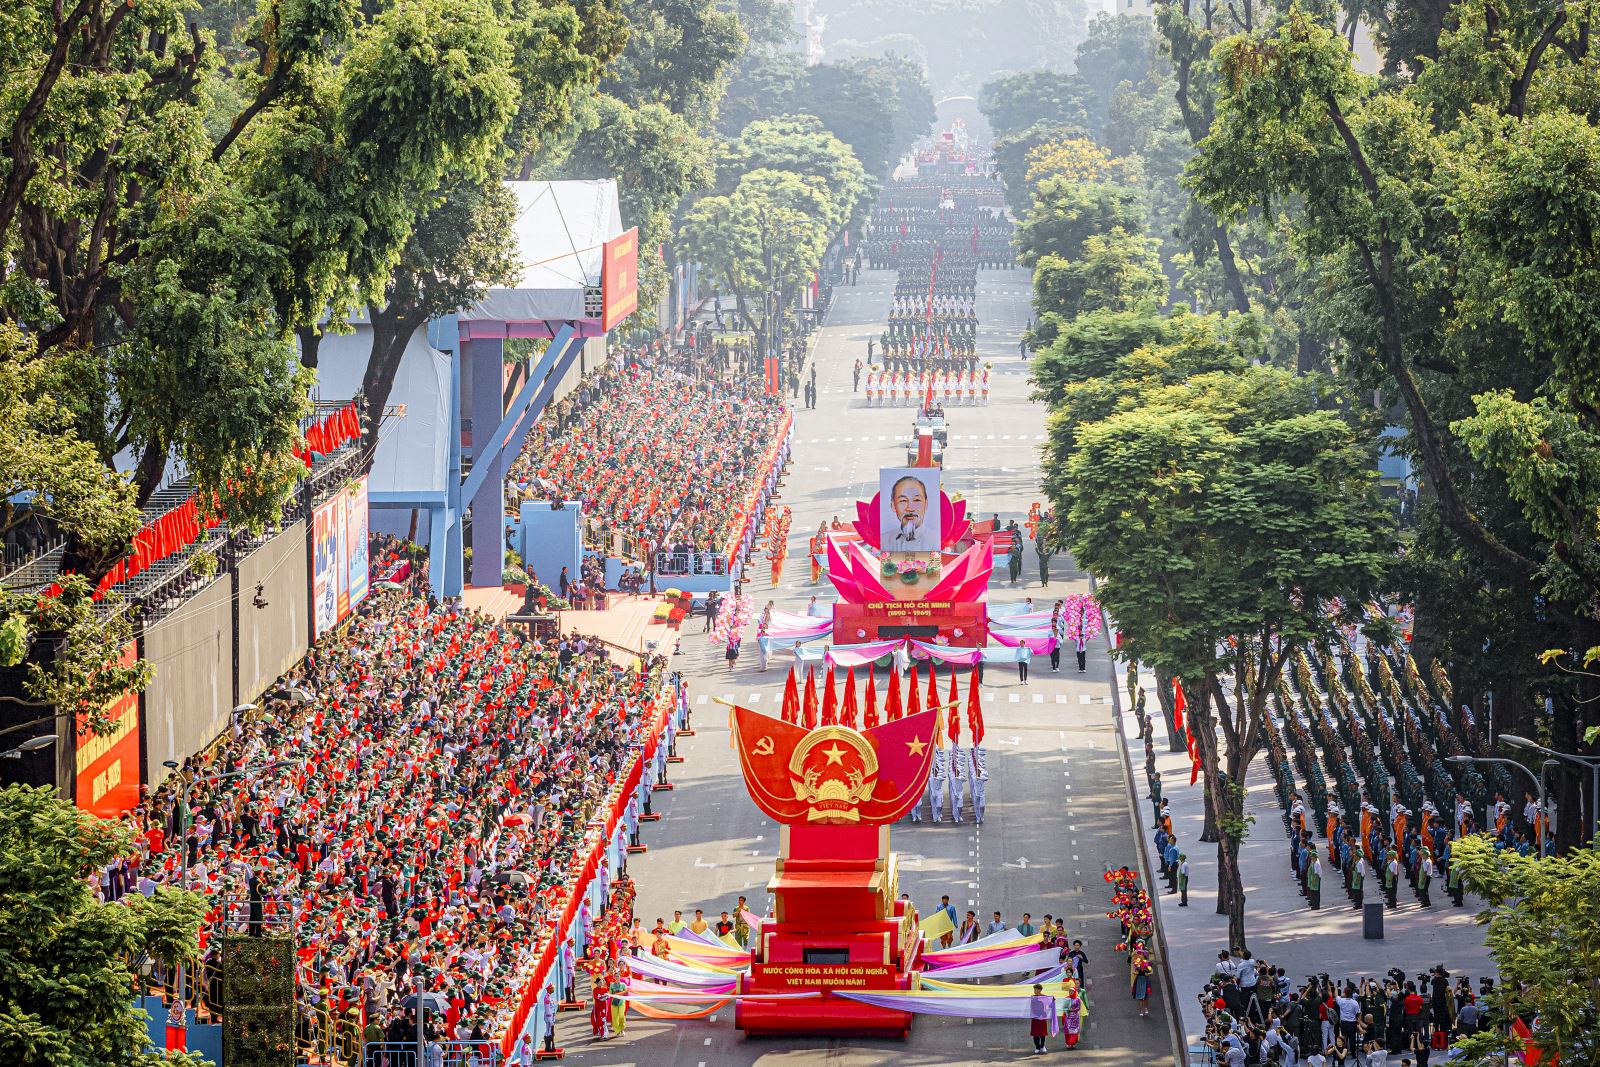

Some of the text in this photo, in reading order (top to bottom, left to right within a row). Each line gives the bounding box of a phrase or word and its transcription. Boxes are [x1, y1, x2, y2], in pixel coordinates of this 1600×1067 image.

[885, 602, 902, 610] TỊCH
[763, 966, 783, 975] NƯỚC
[784, 966, 804, 976] CỘNG
[850, 966, 864, 975] CHỦ
[786, 977, 803, 986] VIỆT
[805, 978, 821, 986] NAM
[822, 977, 844, 986] MUÔN
